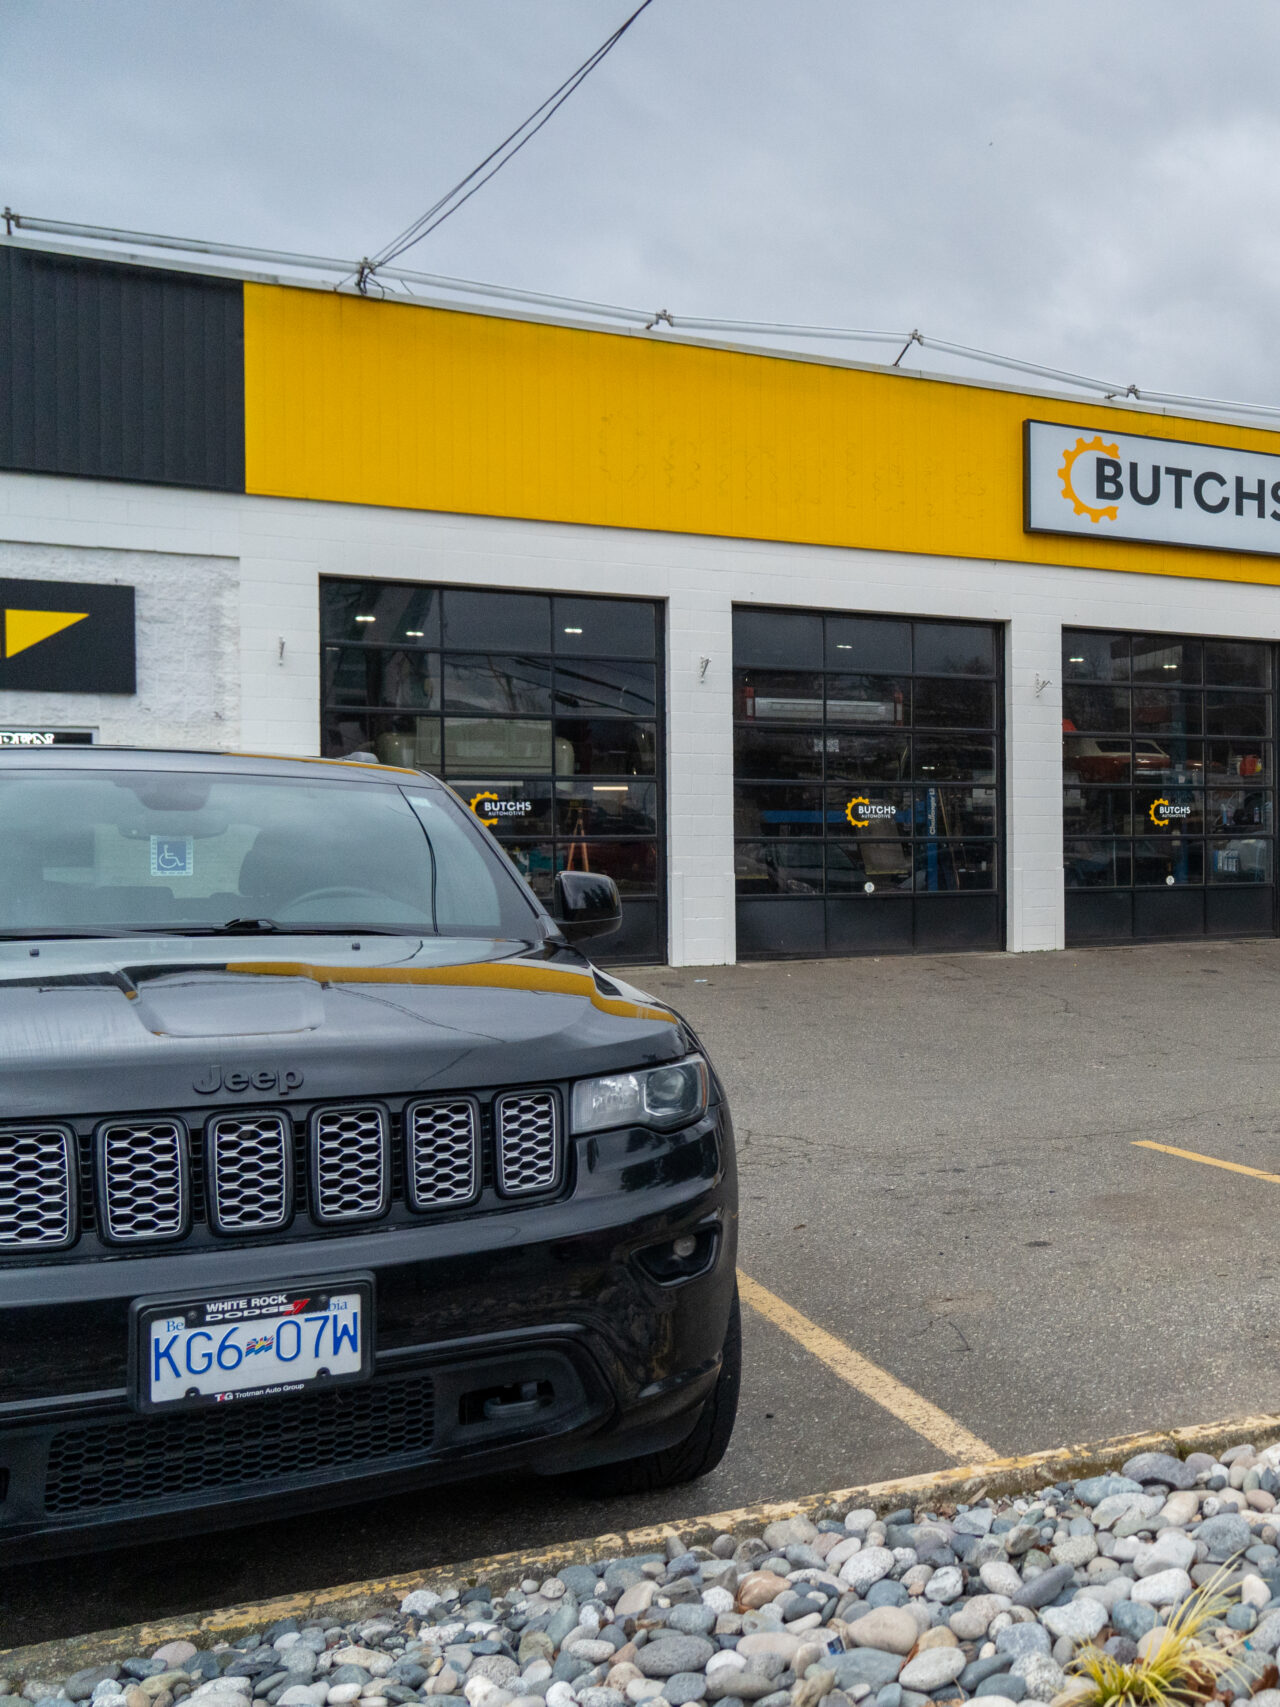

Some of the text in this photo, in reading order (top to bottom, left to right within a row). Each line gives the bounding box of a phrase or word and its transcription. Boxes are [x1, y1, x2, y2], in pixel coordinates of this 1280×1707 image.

[484, 801, 532, 811] BUTCHS
[858, 805, 896, 814] BUTCHS
[1159, 806, 1191, 814] BUTCHS
[192, 1064, 304, 1095] Jeep
[206, 1294, 288, 1313] WHITE ROCK
[205, 1303, 295, 1322] DODGE
[154, 1326, 243, 1382] KG6
[235, 1389, 264, 1399] Trotman
[282, 1383, 305, 1391] Group
